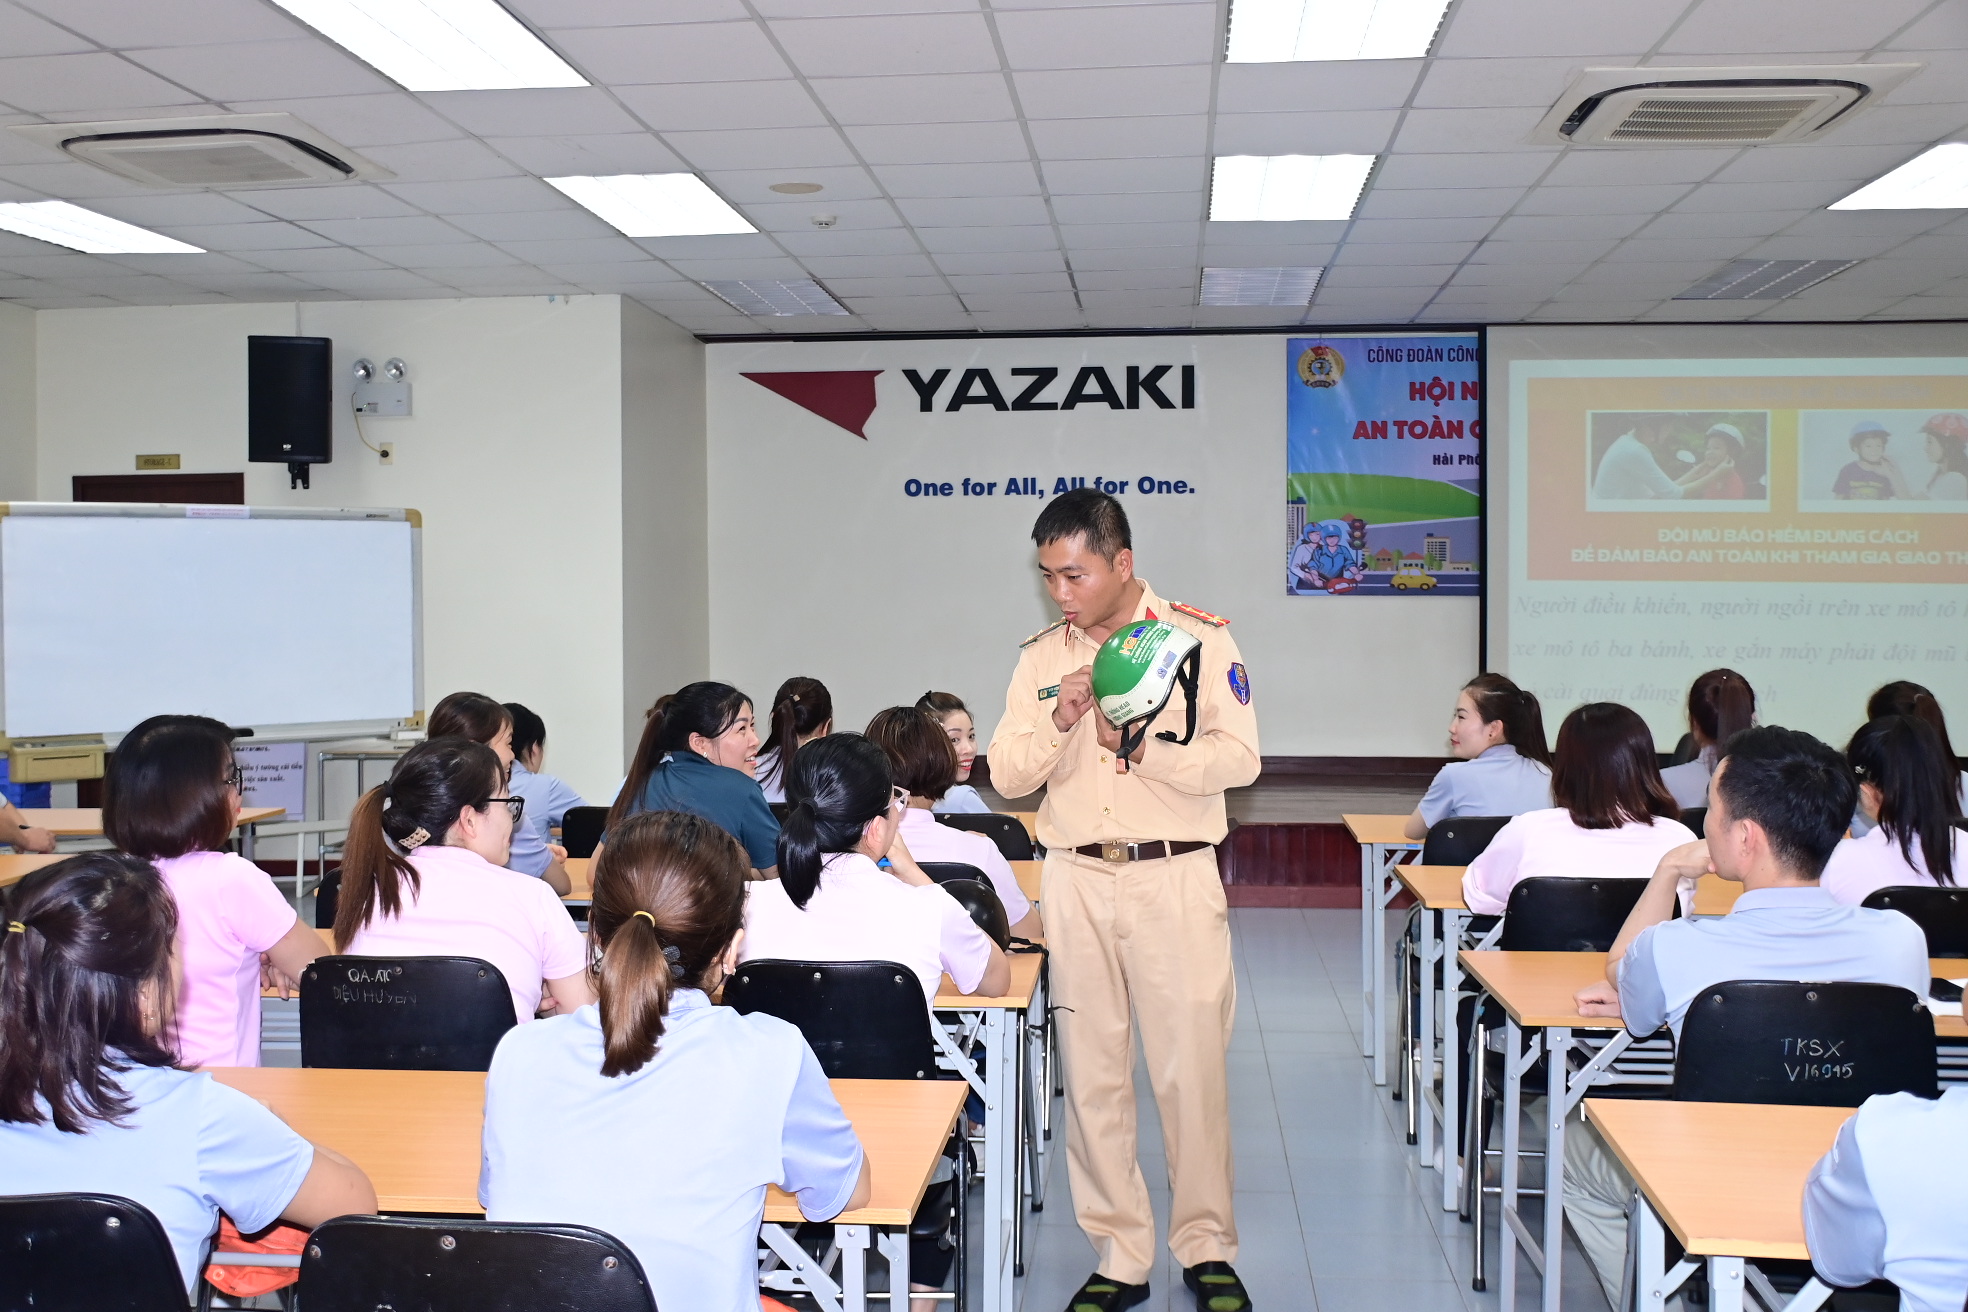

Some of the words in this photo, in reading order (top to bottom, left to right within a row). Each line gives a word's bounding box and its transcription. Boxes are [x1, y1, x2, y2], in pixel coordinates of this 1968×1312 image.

[1368, 346, 1403, 363] CÔNG
[1407, 345, 1443, 363] ĐOÀN
[901, 364, 1195, 412] YAZAKI
[1409, 376, 1455, 407] HỘI
[1352, 420, 1388, 440] AN
[1393, 415, 1464, 440] TOÀN
[1432, 453, 1454, 466] Hải
[904, 478, 954, 497] One
[961, 477, 998, 496] for
[1004, 477, 1045, 500] All,
[1052, 477, 1085, 496] All
[1093, 476, 1129, 495] for
[1137, 476, 1196, 495] One.
[1686, 549, 1714, 563] AN
[1770, 550, 1800, 564] KHI
[1803, 550, 1858, 564] THAM
[1860, 550, 1892, 564] GIA
[1895, 550, 1942, 565] GIAO
[1513, 596, 1577, 618] Người
[1583, 592, 1625, 615] điều
[1700, 596, 1760, 620] người
[1766, 593, 1812, 621] ngồi
[1818, 598, 1860, 617] trên
[1865, 602, 1891, 617] xe
[1896, 600, 1930, 618] mô
[1936, 600, 1957, 618] tô
[1512, 644, 1537, 657] xe
[1543, 640, 1574, 657] mô
[1580, 640, 1600, 658] tô
[1608, 641, 1633, 658] ba
[1701, 645, 1727, 659] xe
[1923, 645, 1957, 662] mũ
[1780, 1037, 1844, 1059] TKSX
